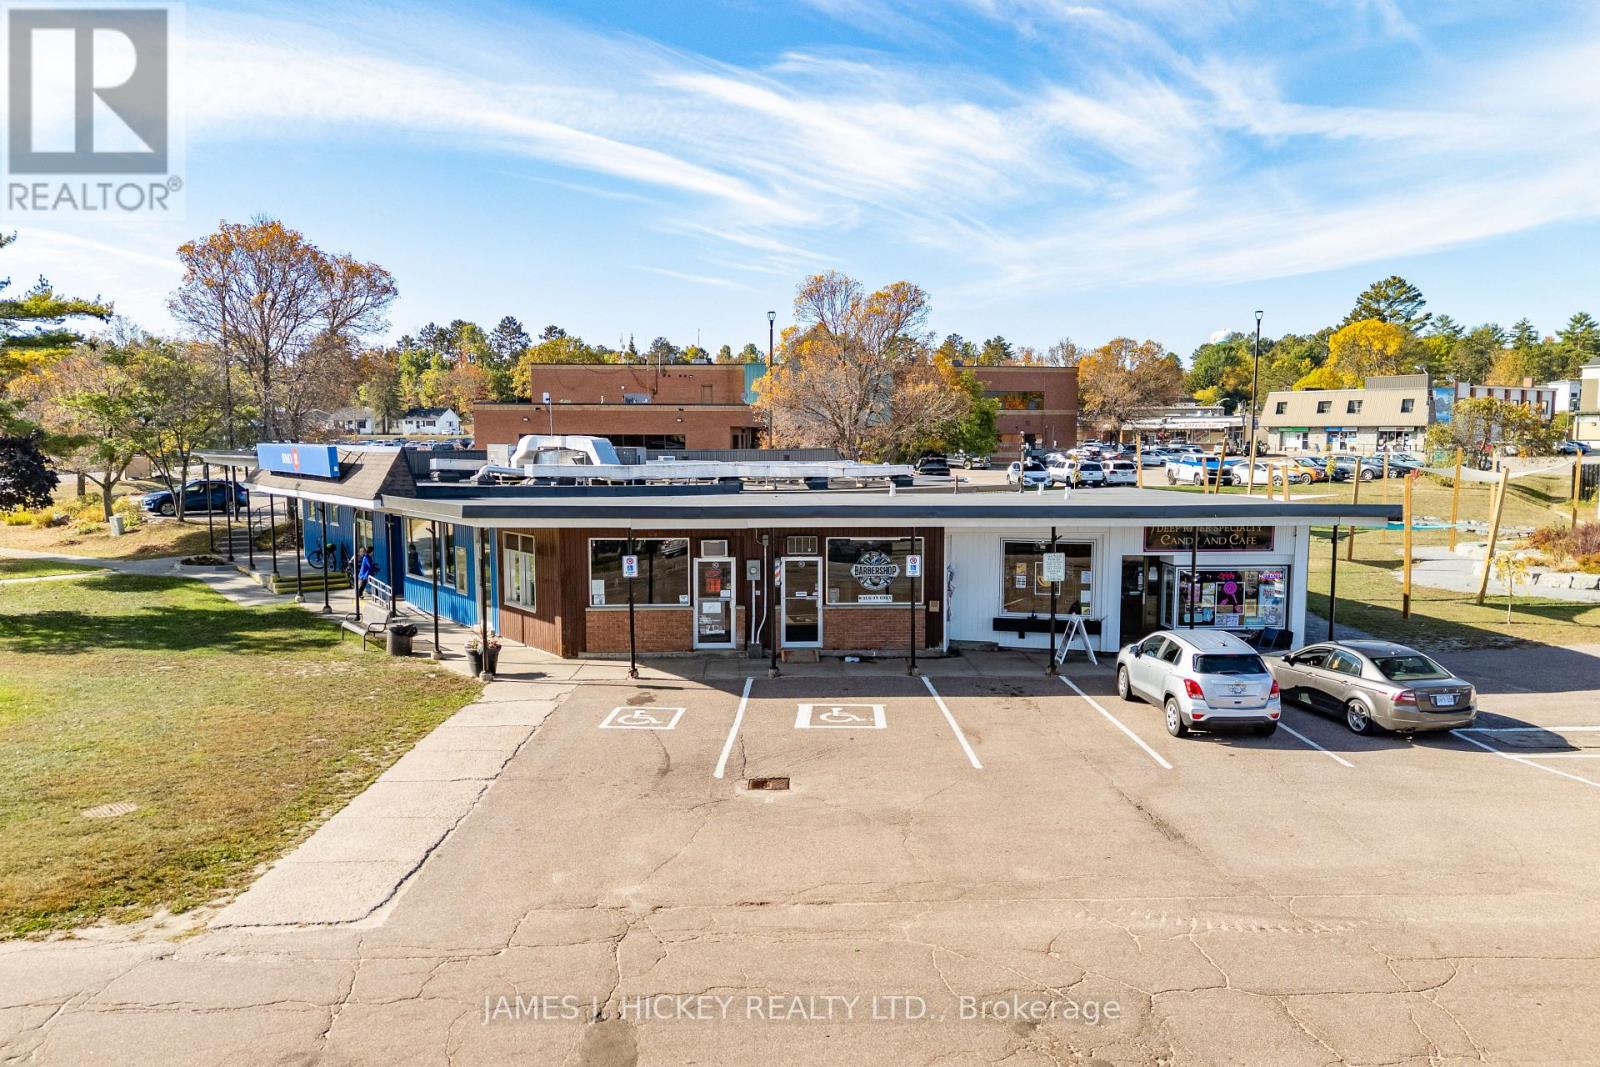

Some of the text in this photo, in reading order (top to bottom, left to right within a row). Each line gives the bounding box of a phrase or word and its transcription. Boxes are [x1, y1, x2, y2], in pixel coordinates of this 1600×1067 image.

[1203, 536, 1227, 545] AND
[1229, 533, 1257, 545] CAFE
[854, 565, 897, 576] BARBERSHOP
